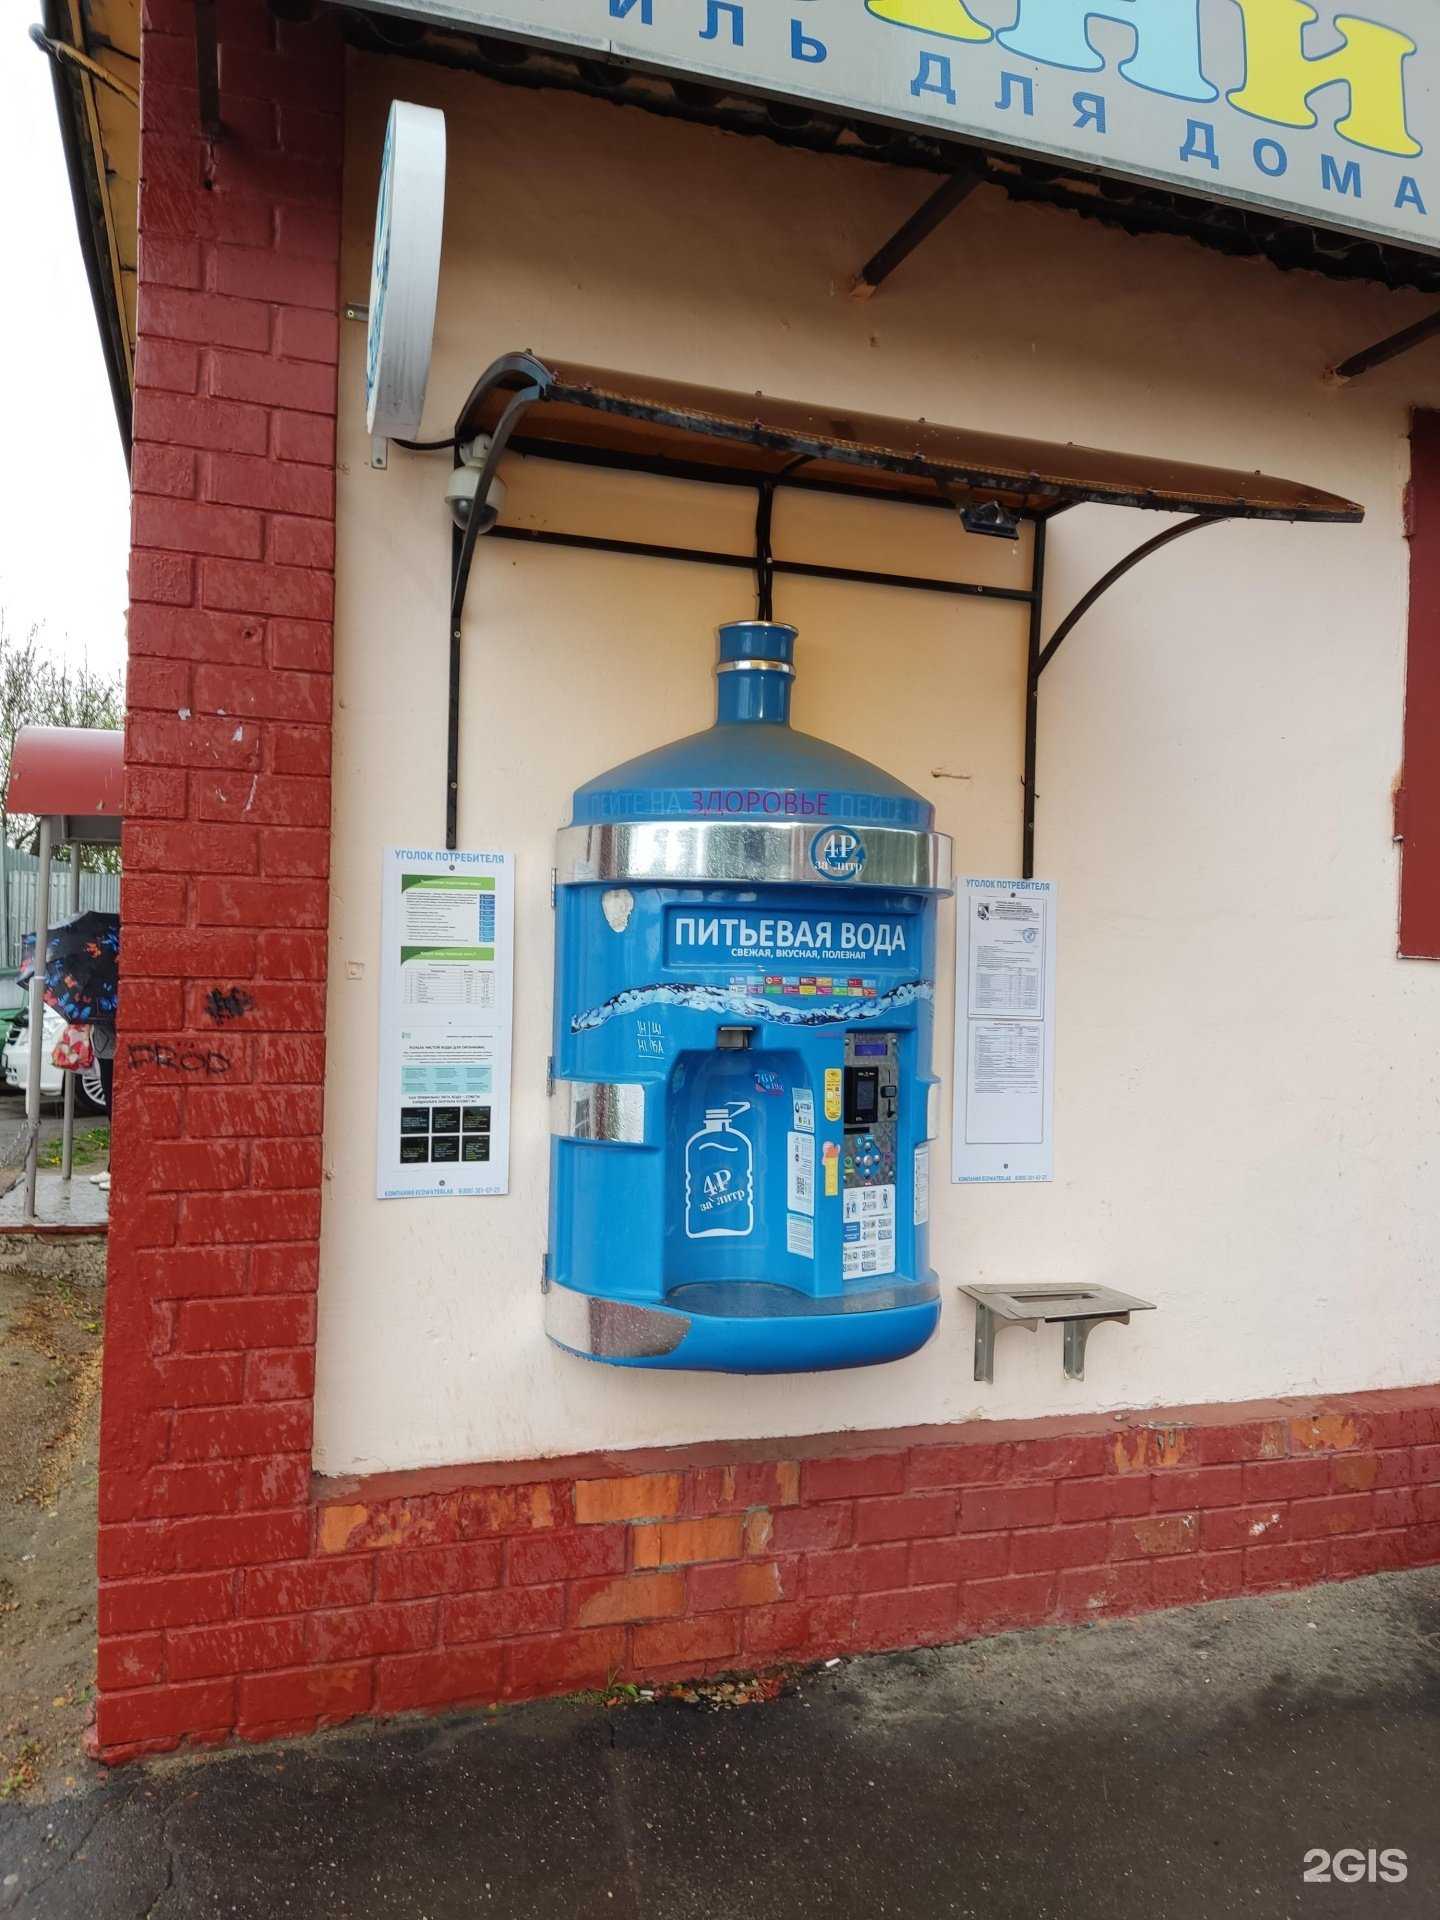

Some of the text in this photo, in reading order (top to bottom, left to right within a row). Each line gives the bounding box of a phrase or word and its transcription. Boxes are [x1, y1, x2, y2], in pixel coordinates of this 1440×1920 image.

[910, 50, 1107, 134] ДЛЯ
[1179, 118, 1428, 215] ДОМА
[691, 790, 832, 817] ЗДОРОВЬЕ
[394, 849, 505, 864] УГОЛОК ПОТРЕБИТЕЛЯ
[966, 879, 1050, 891] УГОЛОК ПОТРЕБИТЕЛЯ
[675, 917, 906, 956] ПИТЬЕВАЯ ВОДА
[731, 948, 866, 960] СВЕЖАЯ, ВКУСНАЯ, ПОЛЕЗНАЯ
